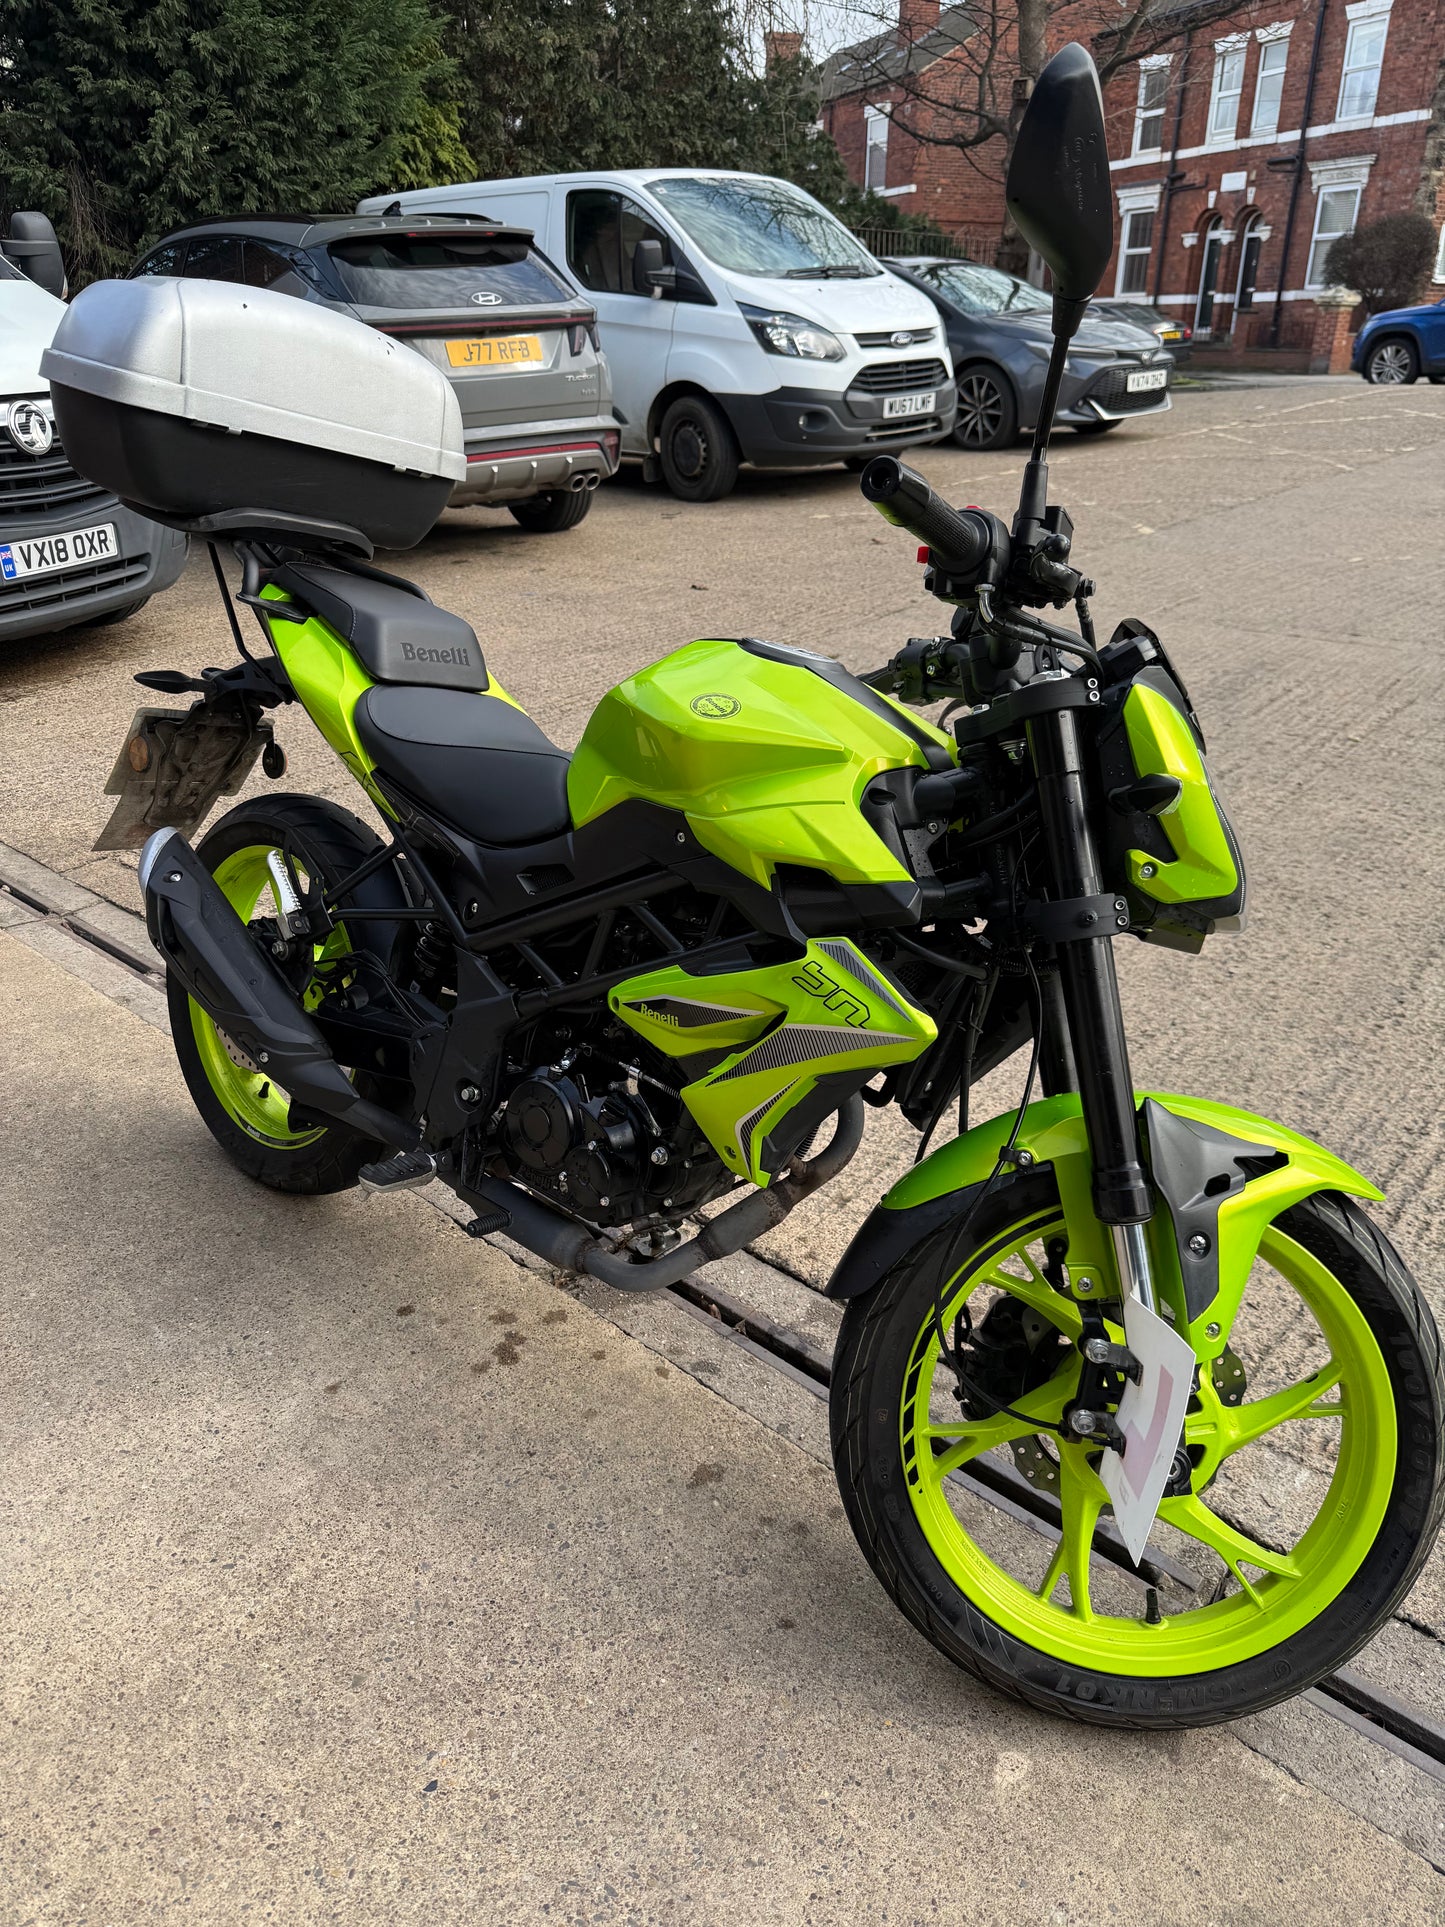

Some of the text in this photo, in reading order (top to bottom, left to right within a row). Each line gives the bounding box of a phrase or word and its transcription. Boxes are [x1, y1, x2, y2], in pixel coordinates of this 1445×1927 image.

[464, 339, 531, 362] J77 RFB
[887, 394, 932, 415] WU67 LMF
[18, 529, 110, 570] VX18 OXR
[4, 564, 14, 572] UK
[400, 642, 471, 667] Benelli
[640, 1002, 680, 1028] Benelli
